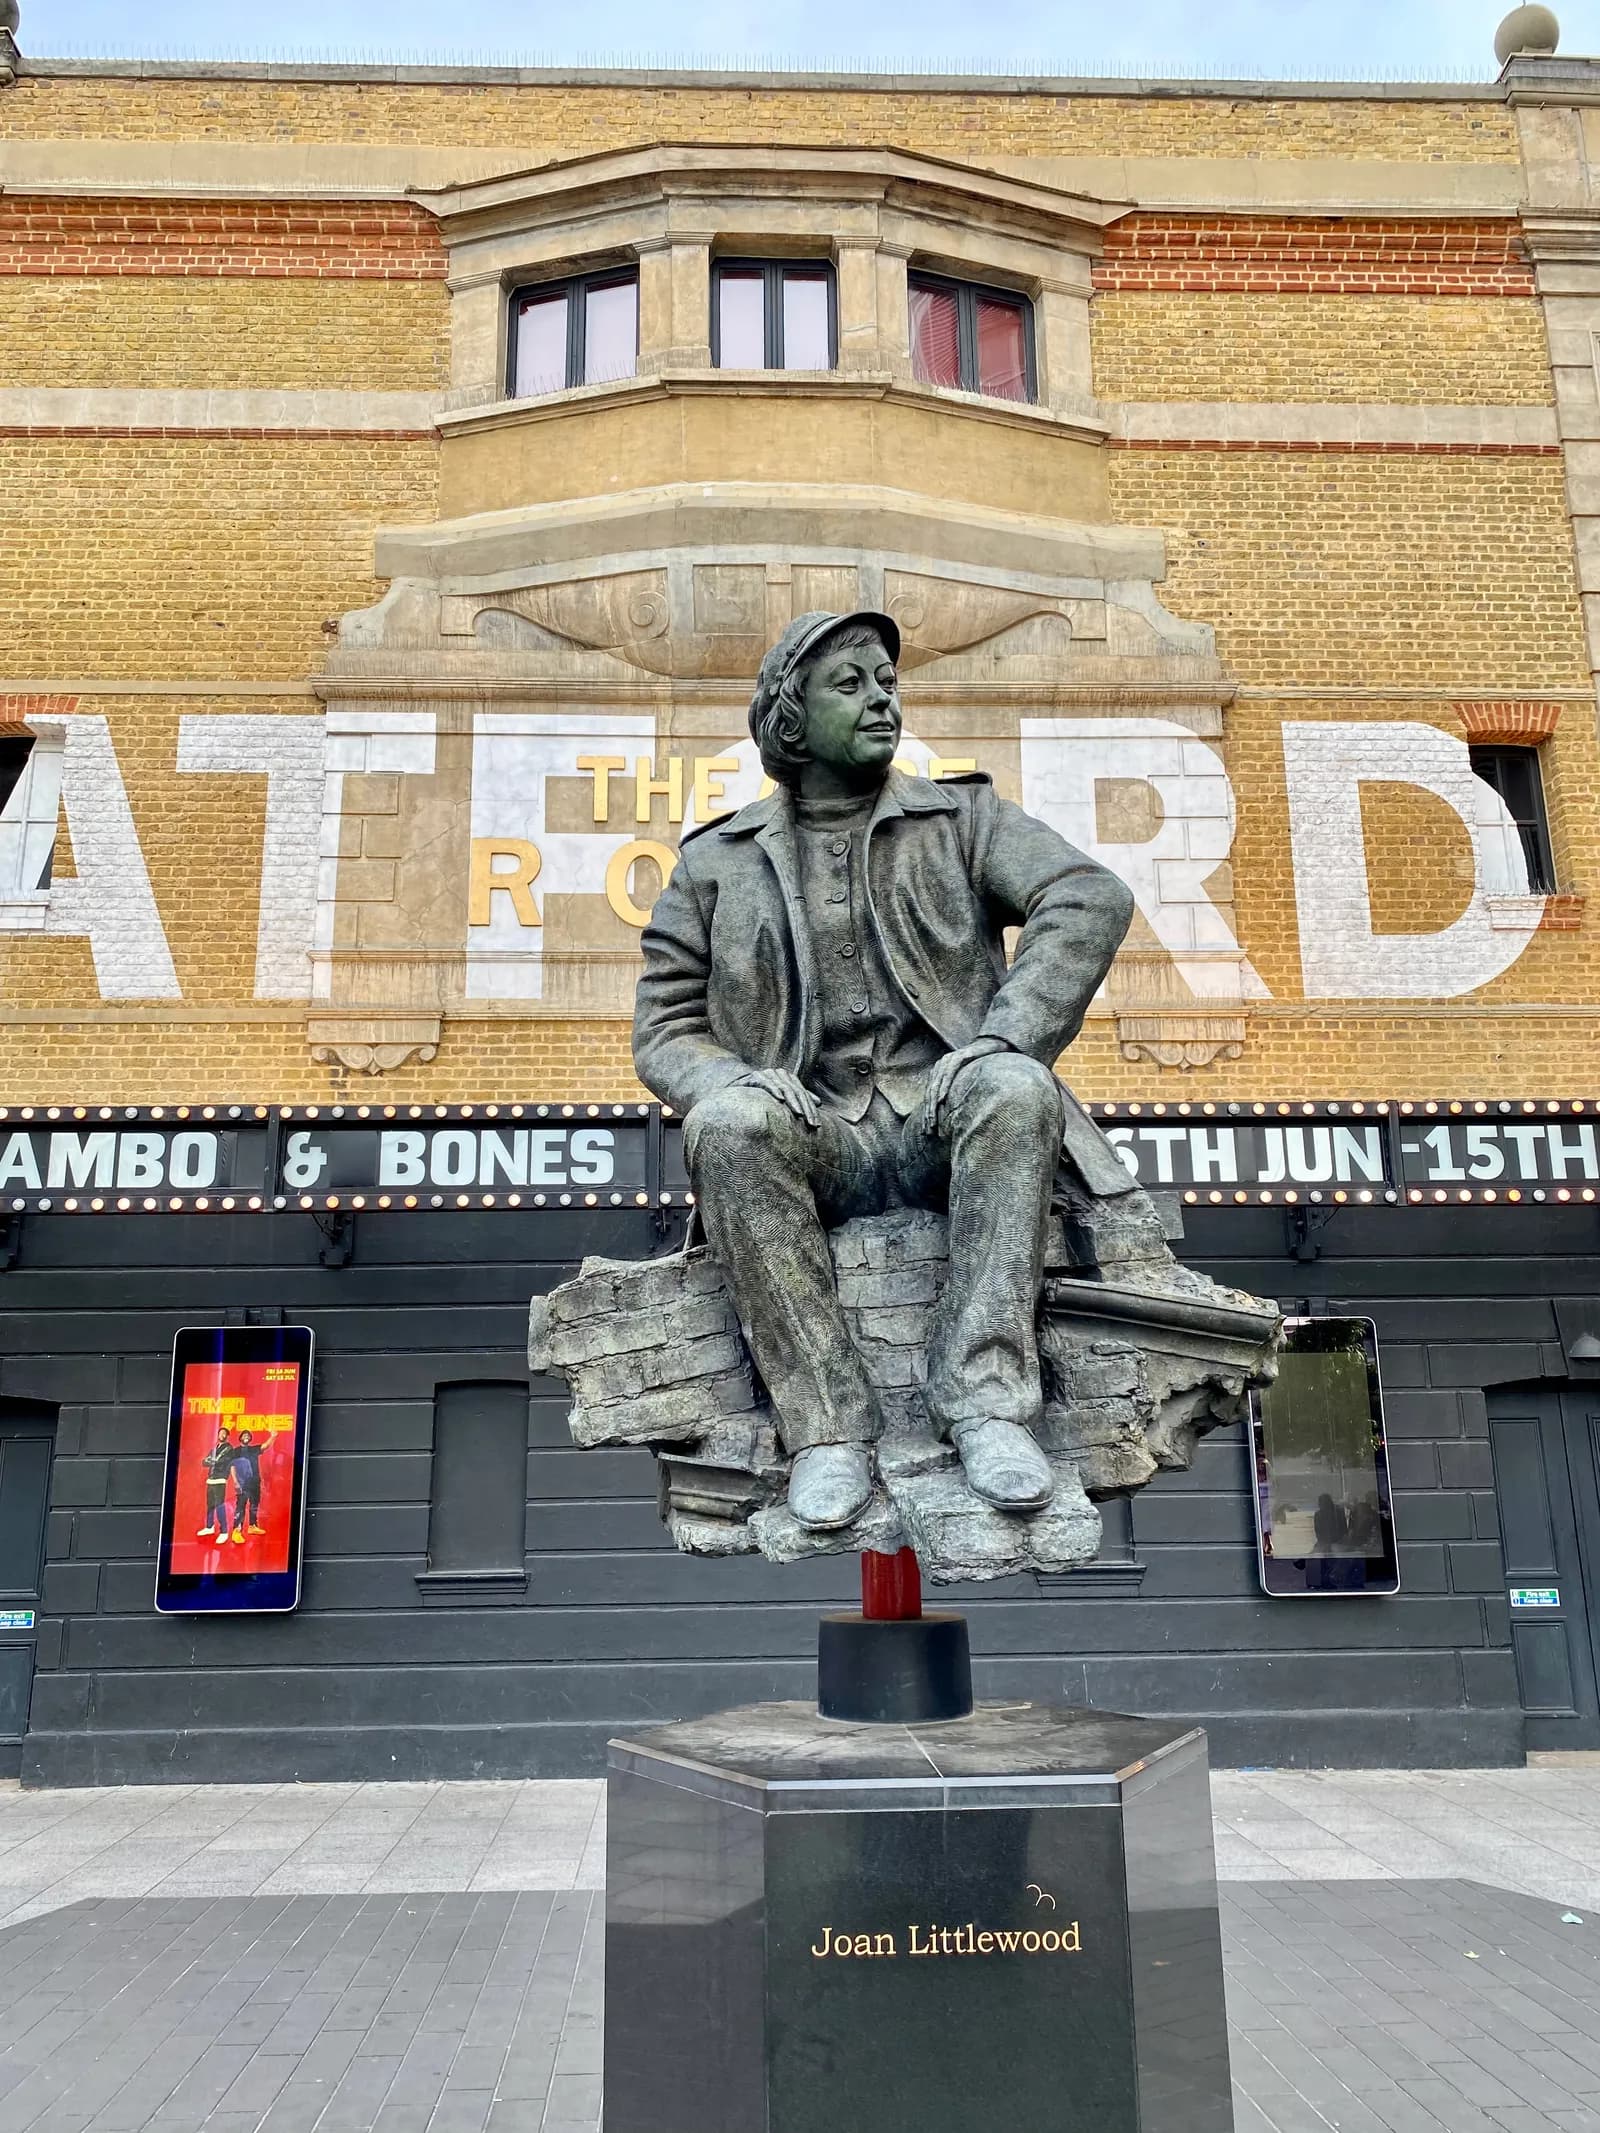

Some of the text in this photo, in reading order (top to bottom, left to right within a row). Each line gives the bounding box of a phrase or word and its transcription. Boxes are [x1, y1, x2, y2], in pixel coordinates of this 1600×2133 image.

[284, 1131, 327, 1188] &
[379, 1129, 614, 1187] BONES
[1257, 1126, 1385, 1182] JUN
[188, 1397, 246, 1415] TAMBO
[236, 1414, 293, 1431] BONES
[811, 1921, 1082, 1957] Joan Littlewood
